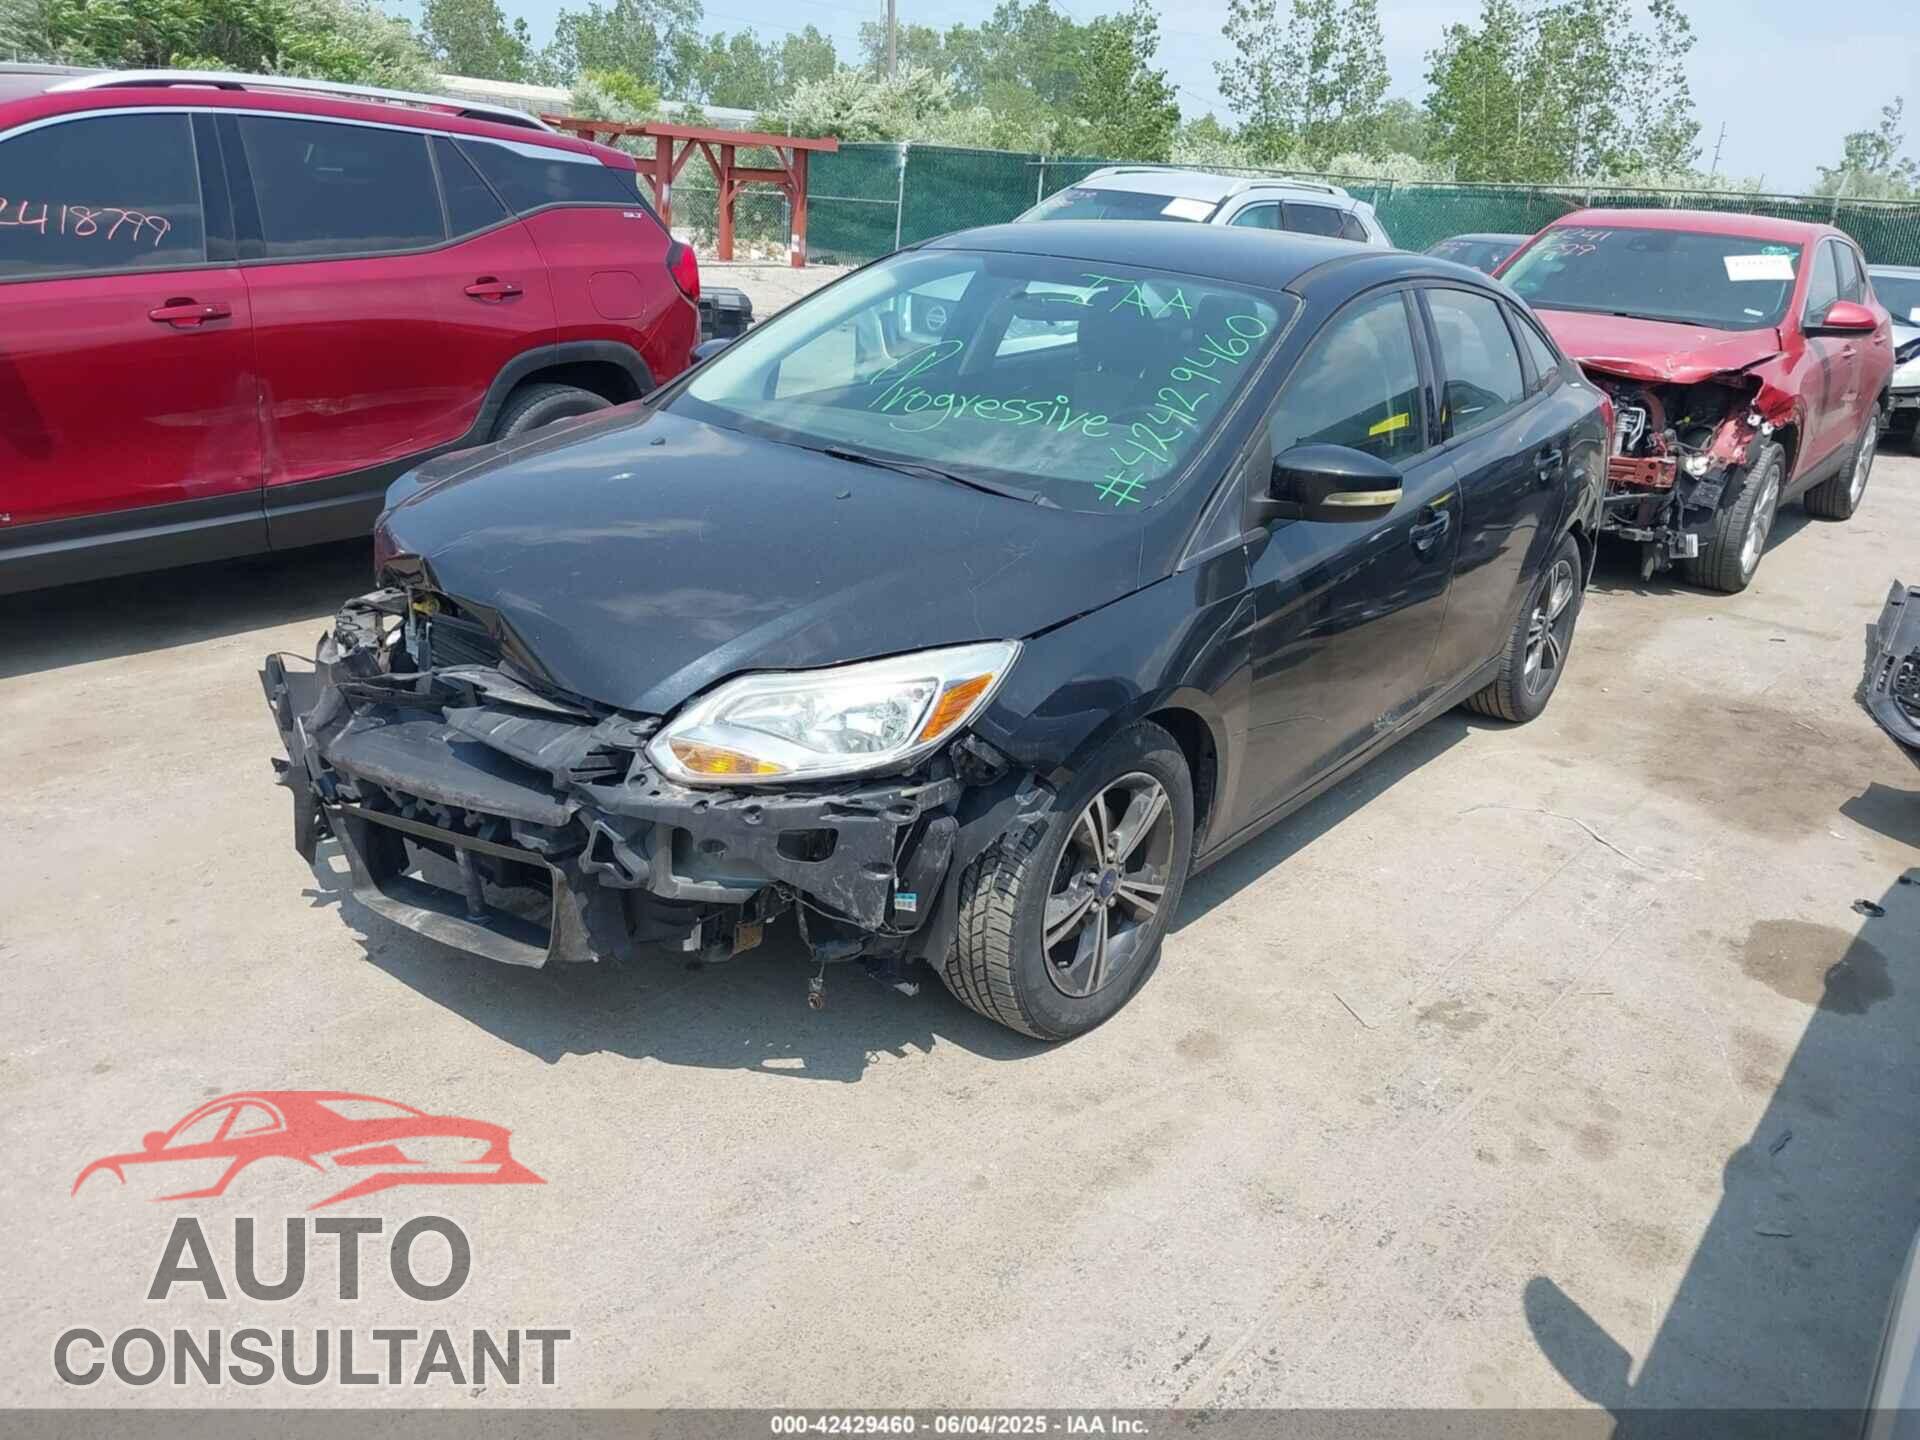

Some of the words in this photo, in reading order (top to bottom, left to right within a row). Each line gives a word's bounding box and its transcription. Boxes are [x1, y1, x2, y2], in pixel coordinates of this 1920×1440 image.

[1060, 273, 1193, 320] IAA
[868, 340, 1109, 437] Progressive
[1094, 315, 1268, 506] #42429460
